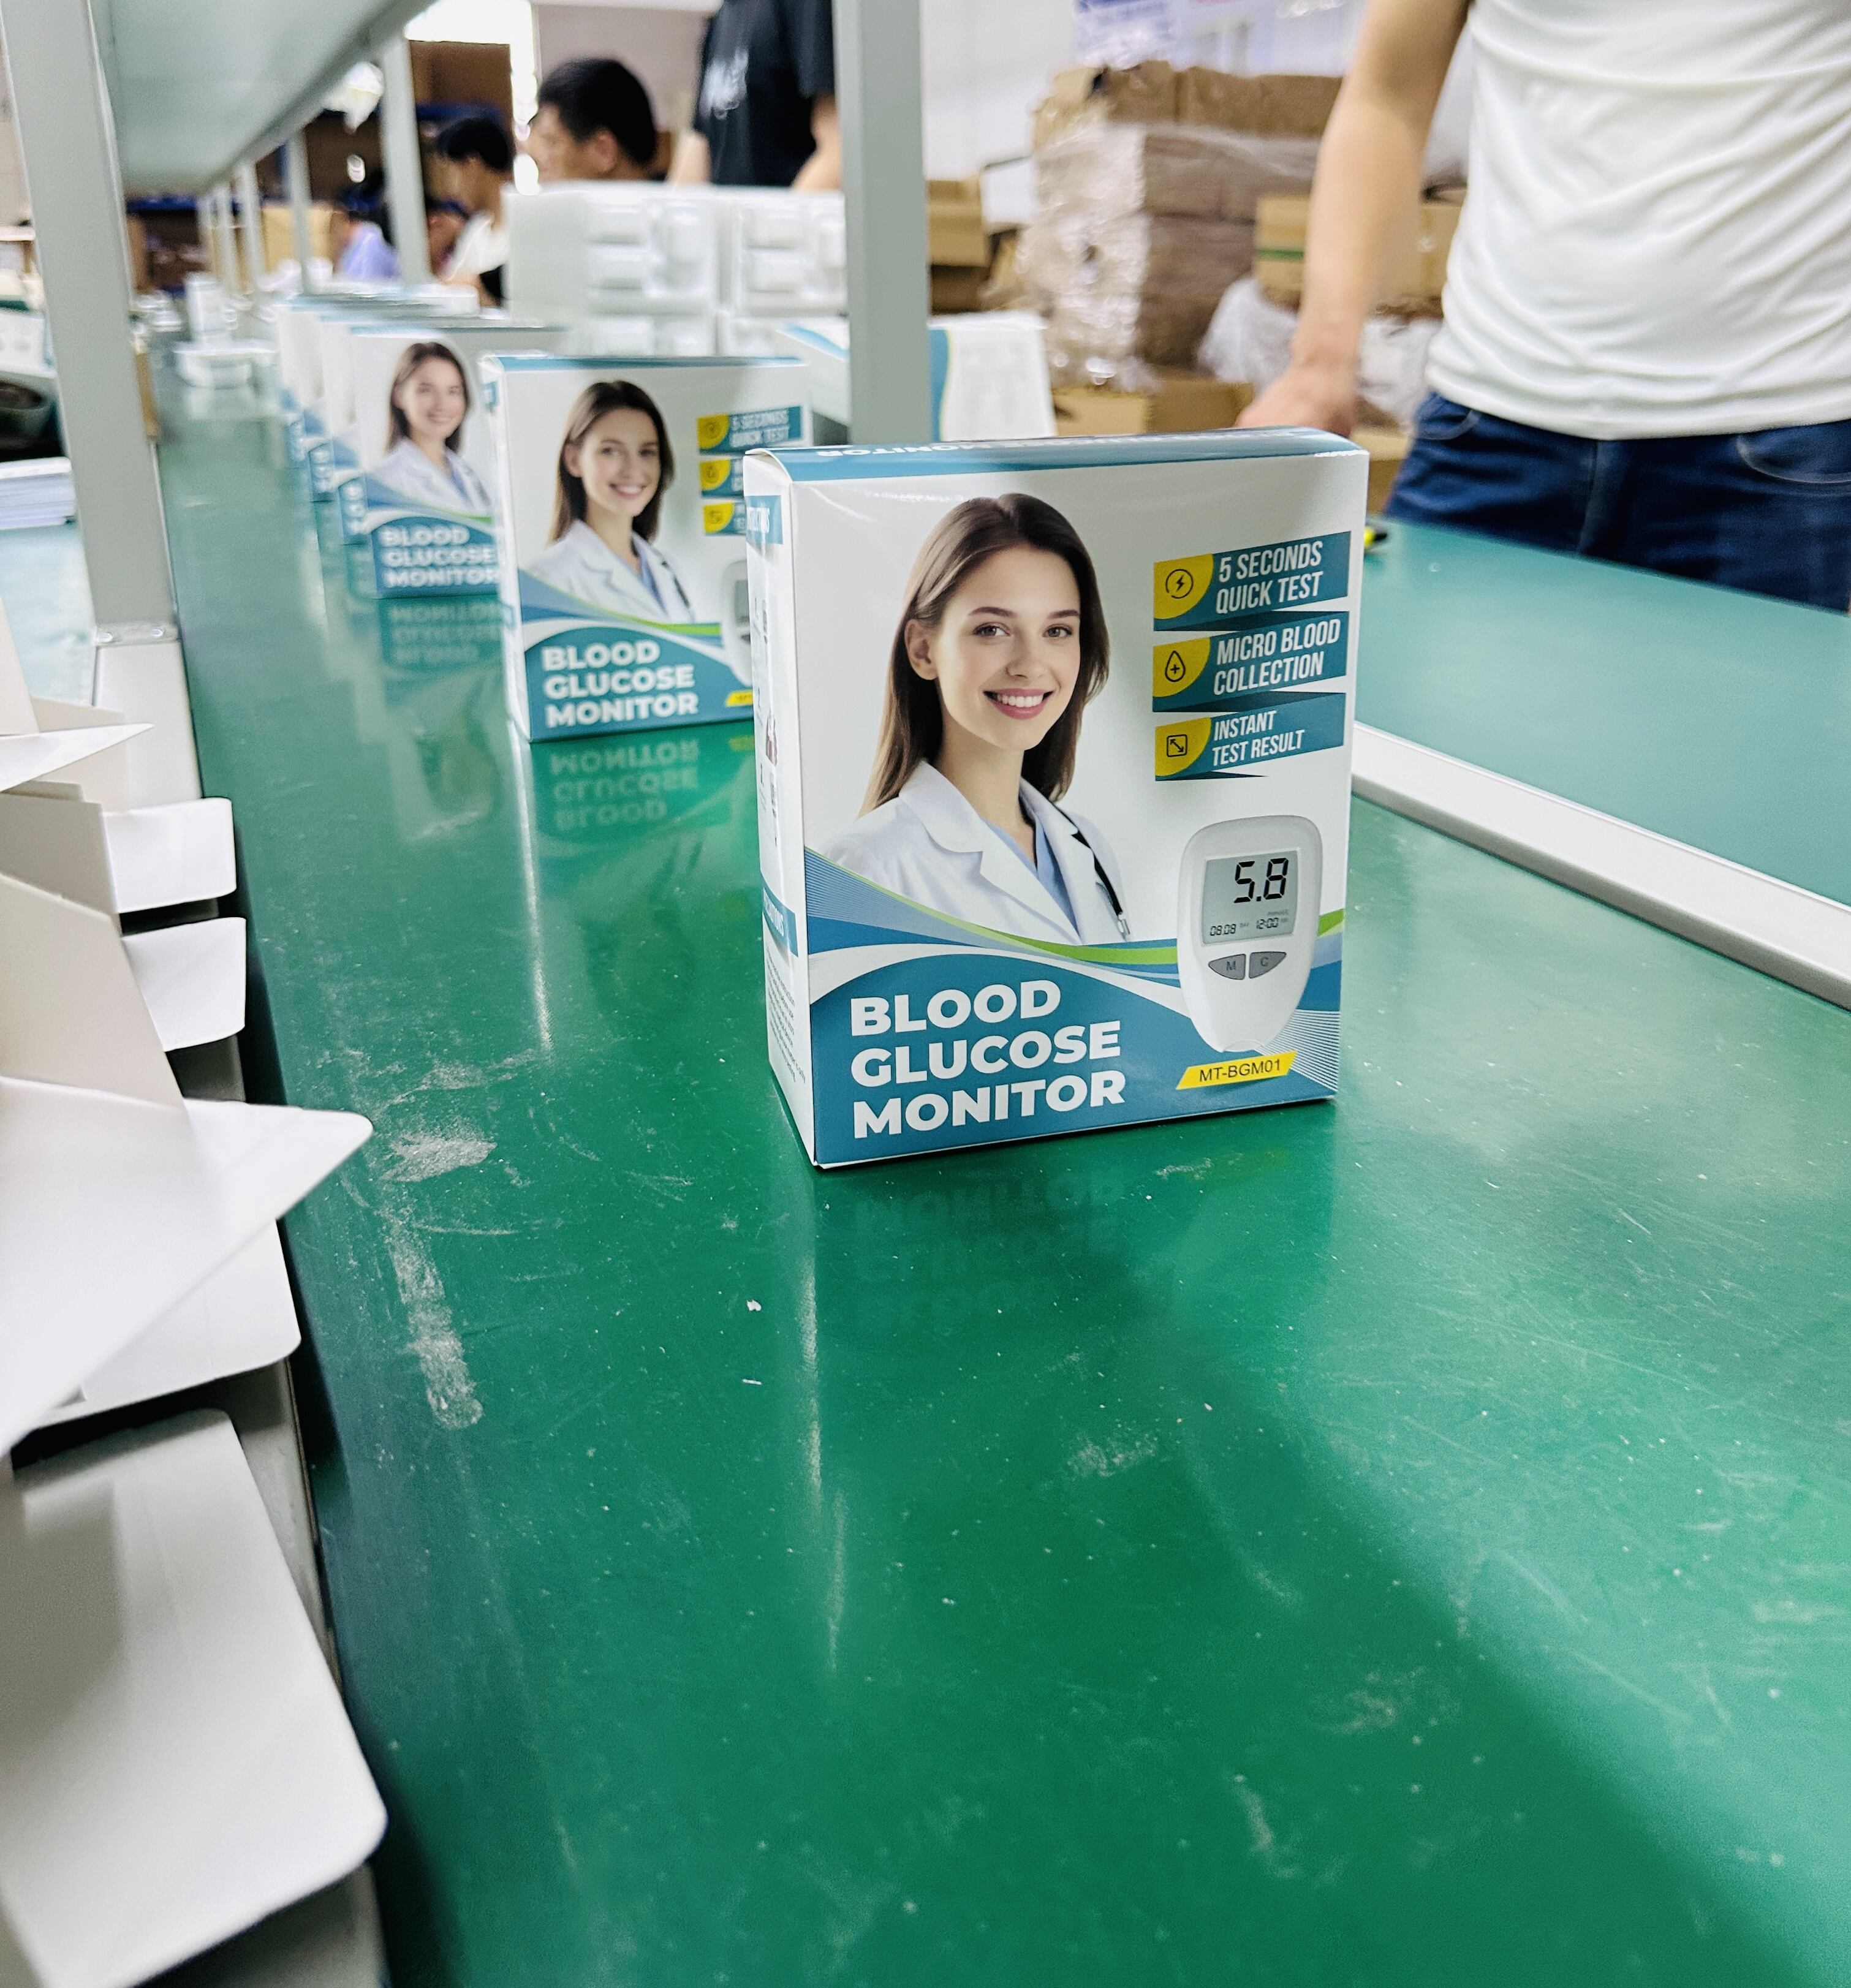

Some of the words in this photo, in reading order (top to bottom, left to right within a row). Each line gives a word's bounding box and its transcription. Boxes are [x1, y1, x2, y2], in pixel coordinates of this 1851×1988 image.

[379, 525, 471, 546] BLOOD
[1219, 556, 1232, 582] 5
[1236, 540, 1323, 578] SECONDS
[1216, 580, 1273, 614] QUICK
[1278, 571, 1323, 603] TEST
[542, 640, 660, 671] BLOOD
[1217, 630, 1277, 665] MICRO
[1281, 618, 1341, 654] BLOOD
[544, 663, 695, 700] GLUCOSE
[1213, 651, 1324, 696] COLLECTION
[545, 691, 699, 728] MONITOR
[1214, 710, 1277, 741] INSTANT
[1212, 741, 1248, 766] TEST
[1251, 730, 1305, 760] RESULT
[1234, 858, 1289, 904] 5.8
[1226, 960, 1236, 971] M
[1260, 956, 1269, 967] C
[850, 980, 1061, 1037] BLOOD
[851, 1020, 1121, 1087] GLUCOSE
[1200, 1059, 1280, 1083] MT-BGM01
[854, 1070, 1126, 1140] MONITOR
